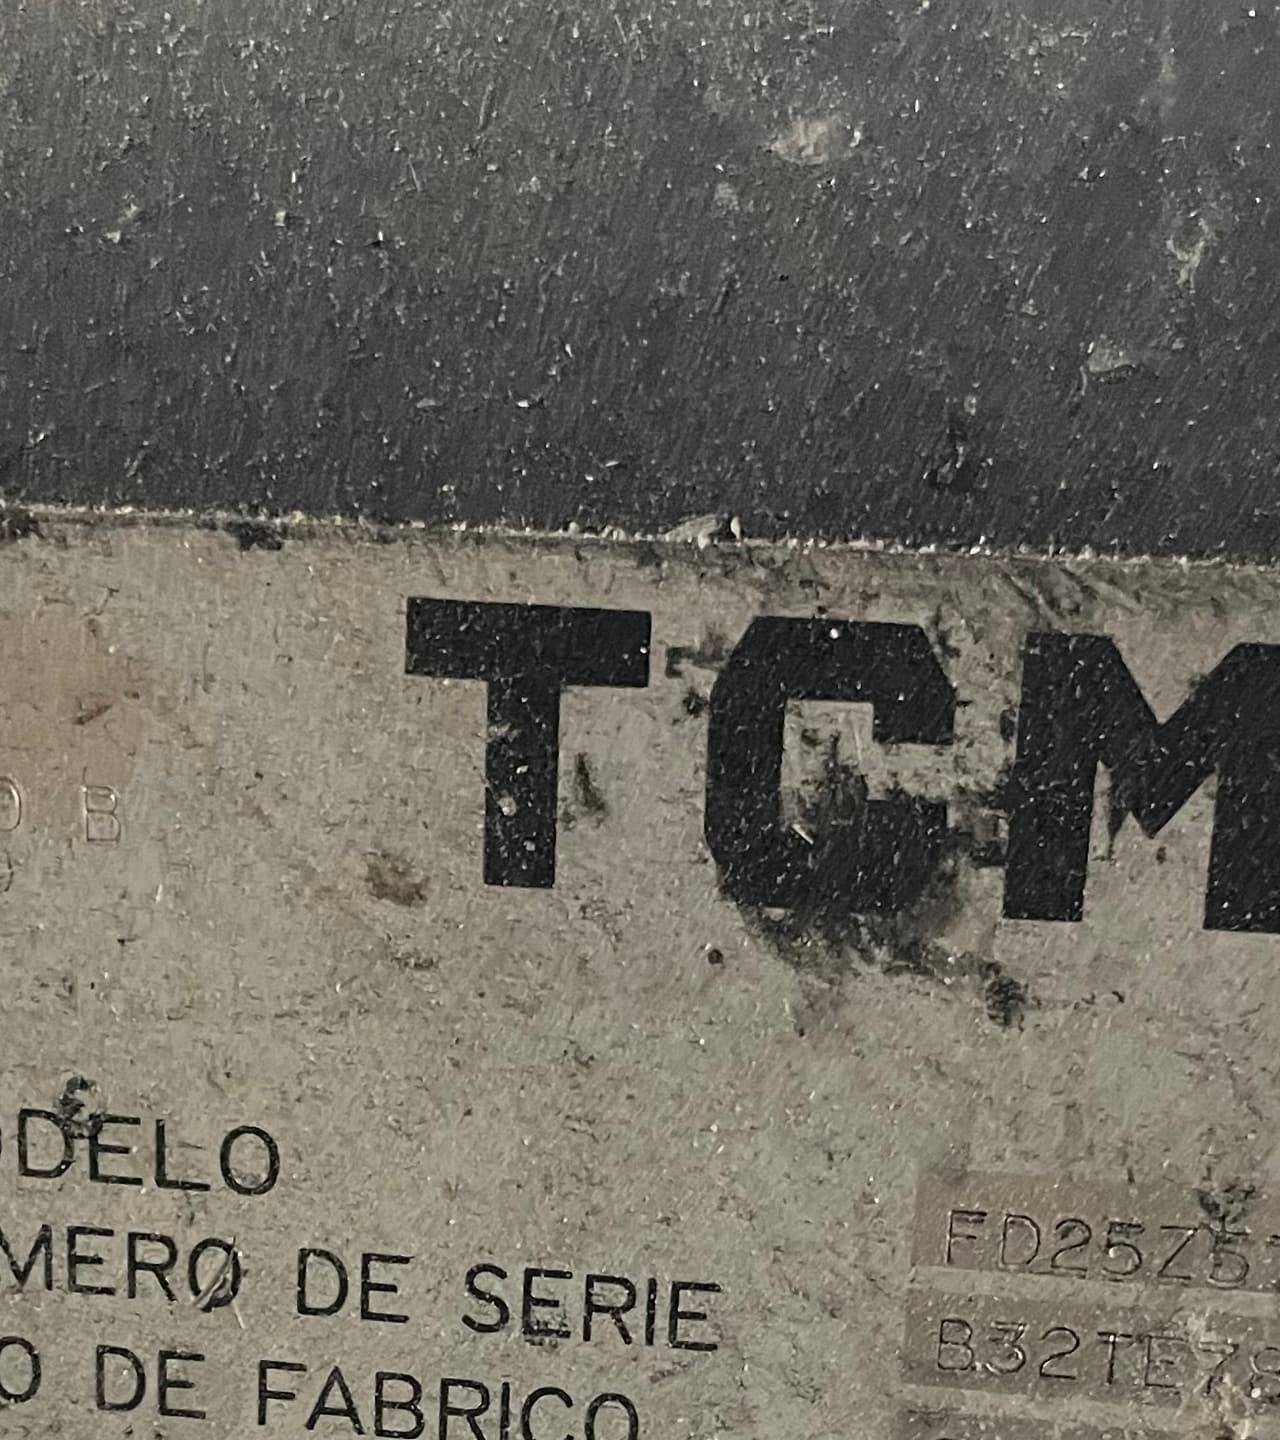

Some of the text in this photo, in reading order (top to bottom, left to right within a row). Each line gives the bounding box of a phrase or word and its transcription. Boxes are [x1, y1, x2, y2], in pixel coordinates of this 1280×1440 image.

[296, 1247, 414, 1324] DE
[461, 1263, 721, 1353] SERIE
[94, 1344, 208, 1421] DE
